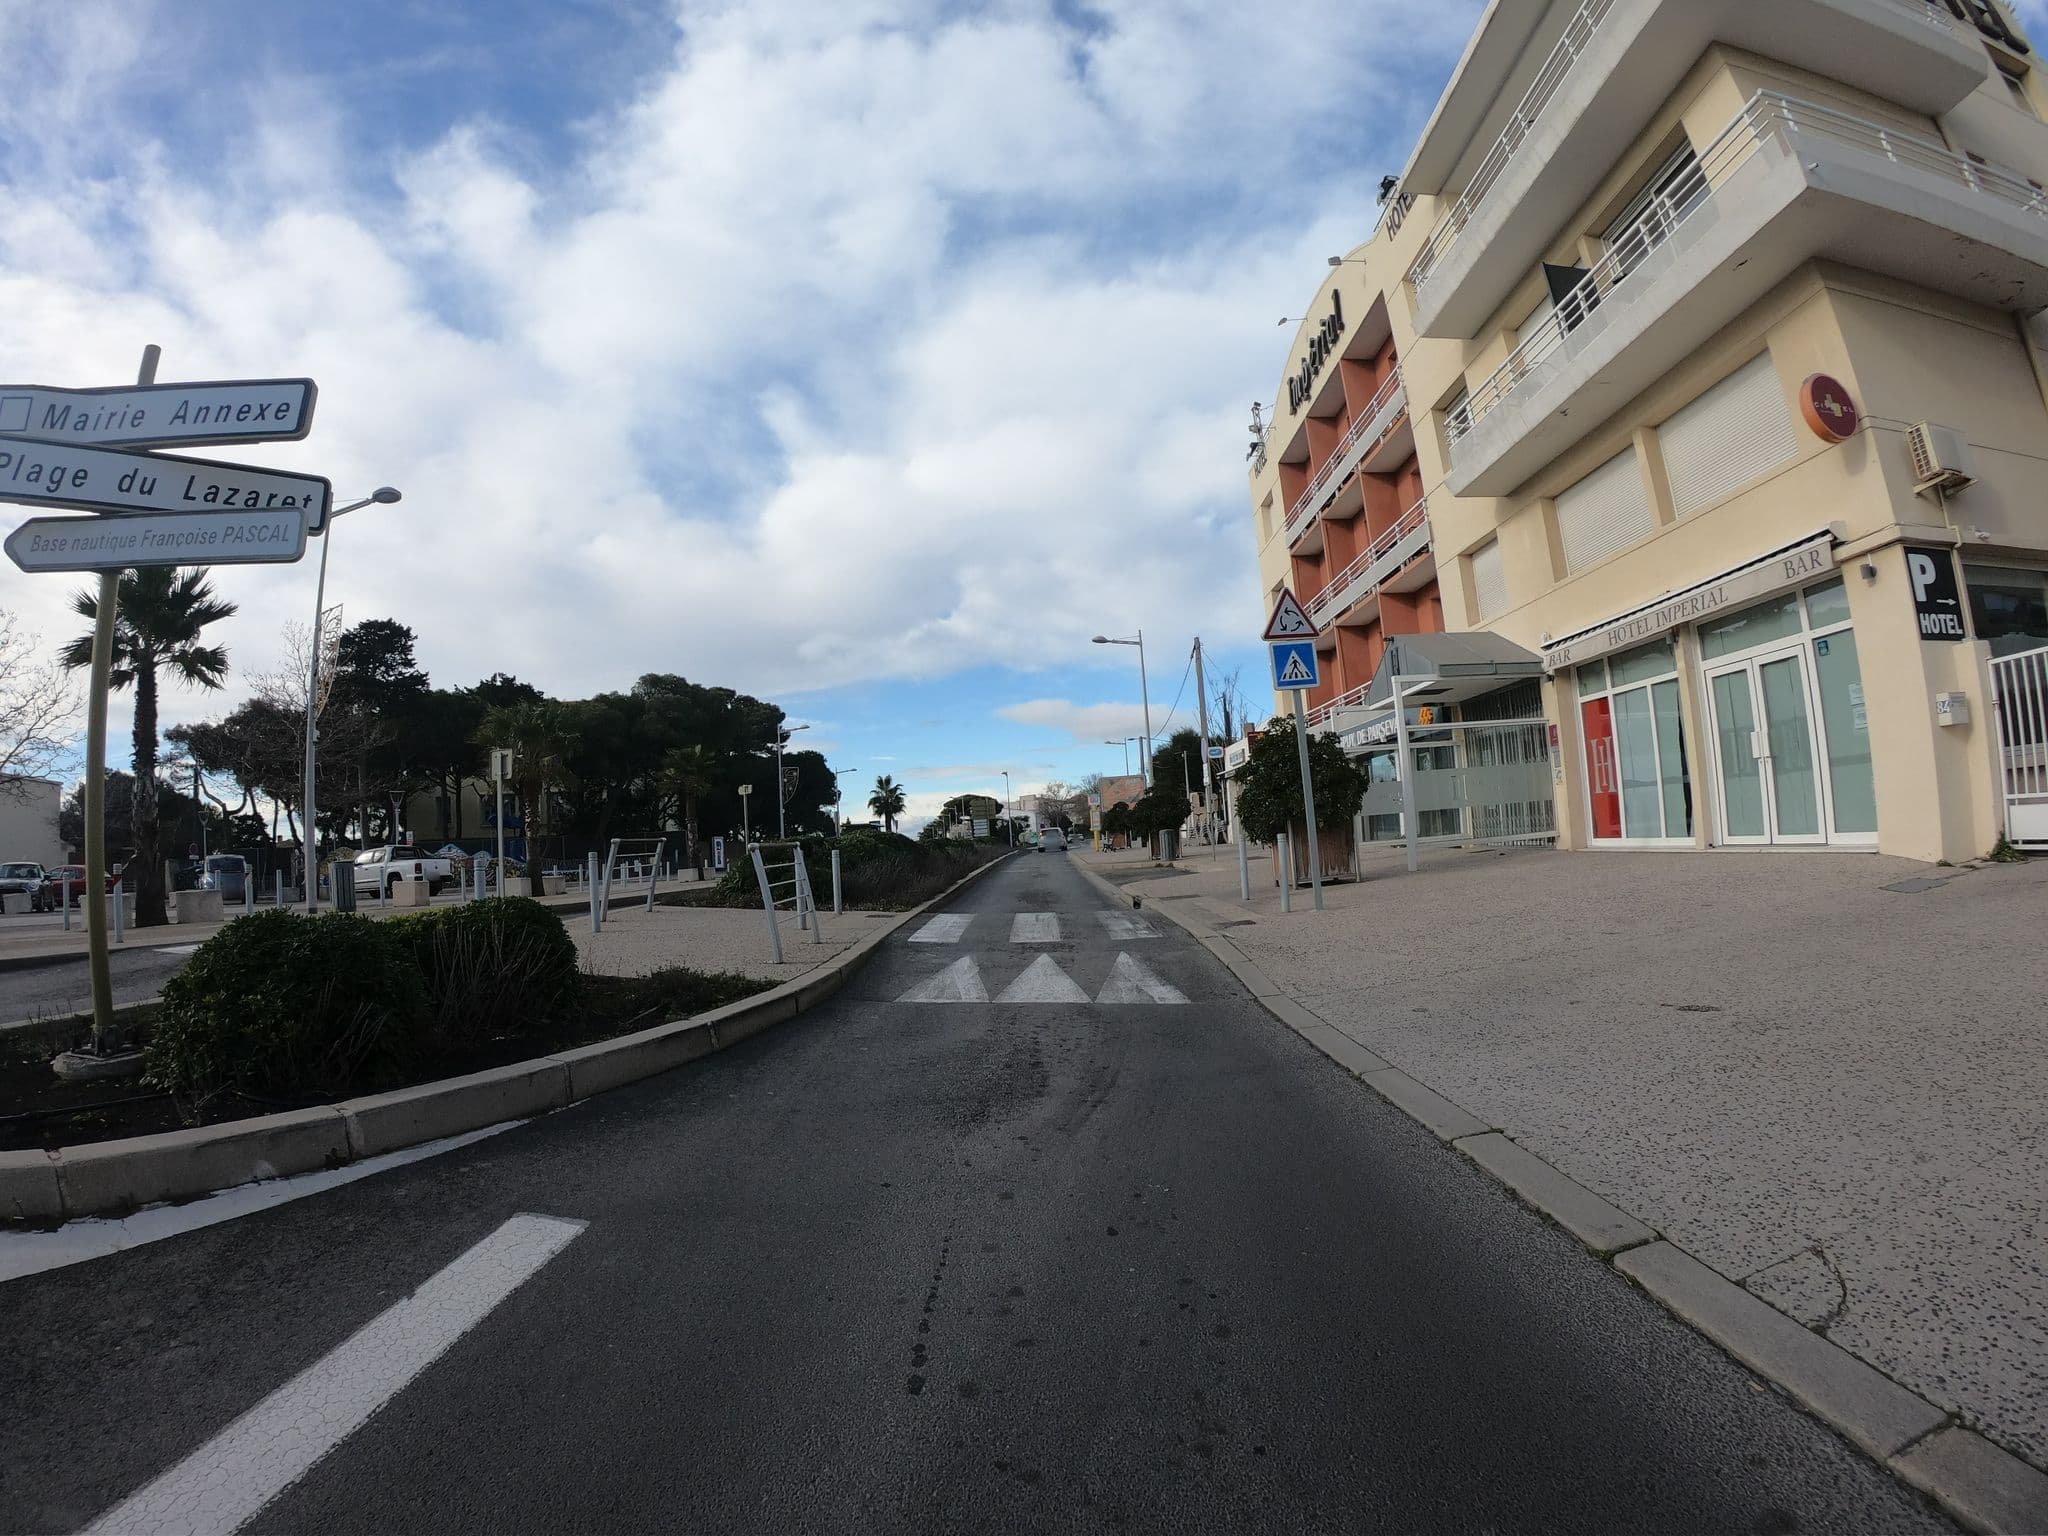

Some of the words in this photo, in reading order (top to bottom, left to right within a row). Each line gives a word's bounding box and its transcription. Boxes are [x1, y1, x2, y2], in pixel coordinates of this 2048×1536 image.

[41, 403, 146, 432] Mairie
[169, 400, 291, 425] Annexe
[0, 452, 89, 493] Plage
[117, 467, 158, 496] du
[182, 475, 313, 508] Lazaret
[29, 534, 68, 552] Base
[71, 532, 137, 553] nautique
[140, 527, 217, 547] Françoise
[222, 524, 289, 544] PASCAL
[1782, 549, 1823, 579] BAR
[1907, 553, 1936, 602] P
[1607, 617, 1653, 646] HOTEL
[1656, 587, 1729, 628] IMPERIAL
[1920, 613, 1963, 635] HOTEL
[1549, 649, 1571, 667] BAR
[1936, 700, 1951, 714] 84
[1367, 718, 1399, 742] PARSEVA
